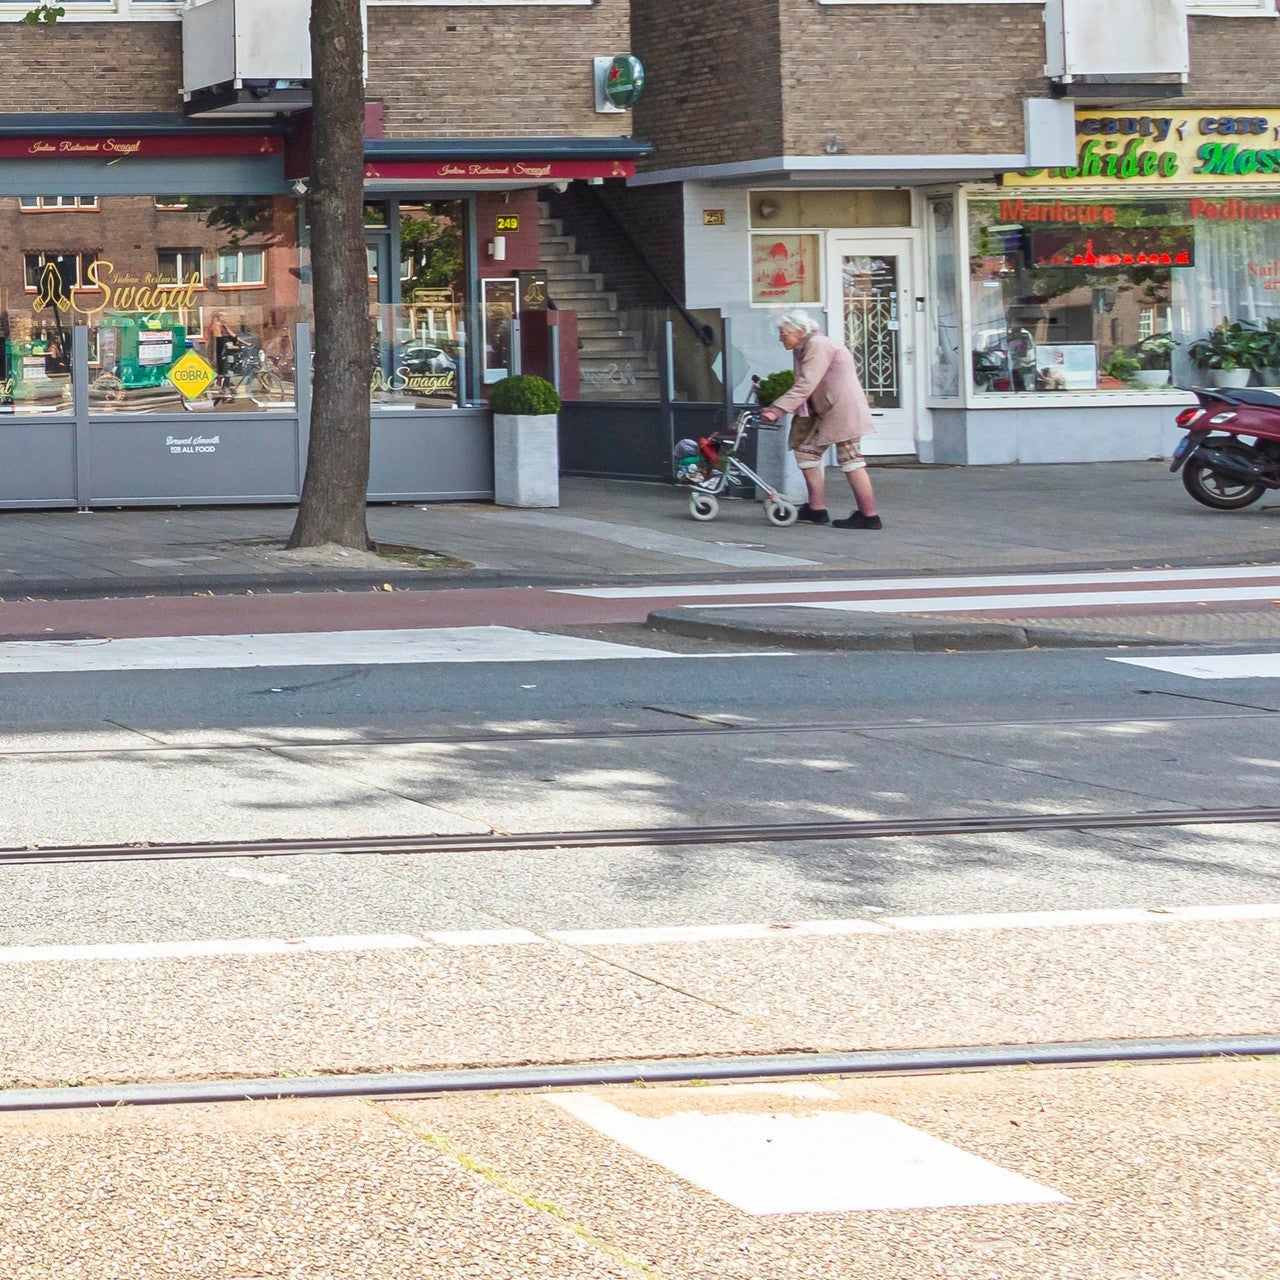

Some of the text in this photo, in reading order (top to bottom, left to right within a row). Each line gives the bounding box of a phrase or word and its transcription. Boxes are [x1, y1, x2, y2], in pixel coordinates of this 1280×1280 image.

[1076, 117, 1268, 142] eauty care
[28, 138, 141, 155] Indian Restaurant Swagat
[438, 164, 466, 176] Indian
[468, 164, 509, 175] Restaurant
[706, 212, 724, 223] 251
[999, 199, 1116, 223] Manicure
[497, 218, 518, 229] 249
[70, 260, 200, 326] Swagat
[174, 370, 209, 381] COBRA
[387, 366, 454, 395] Swagat
